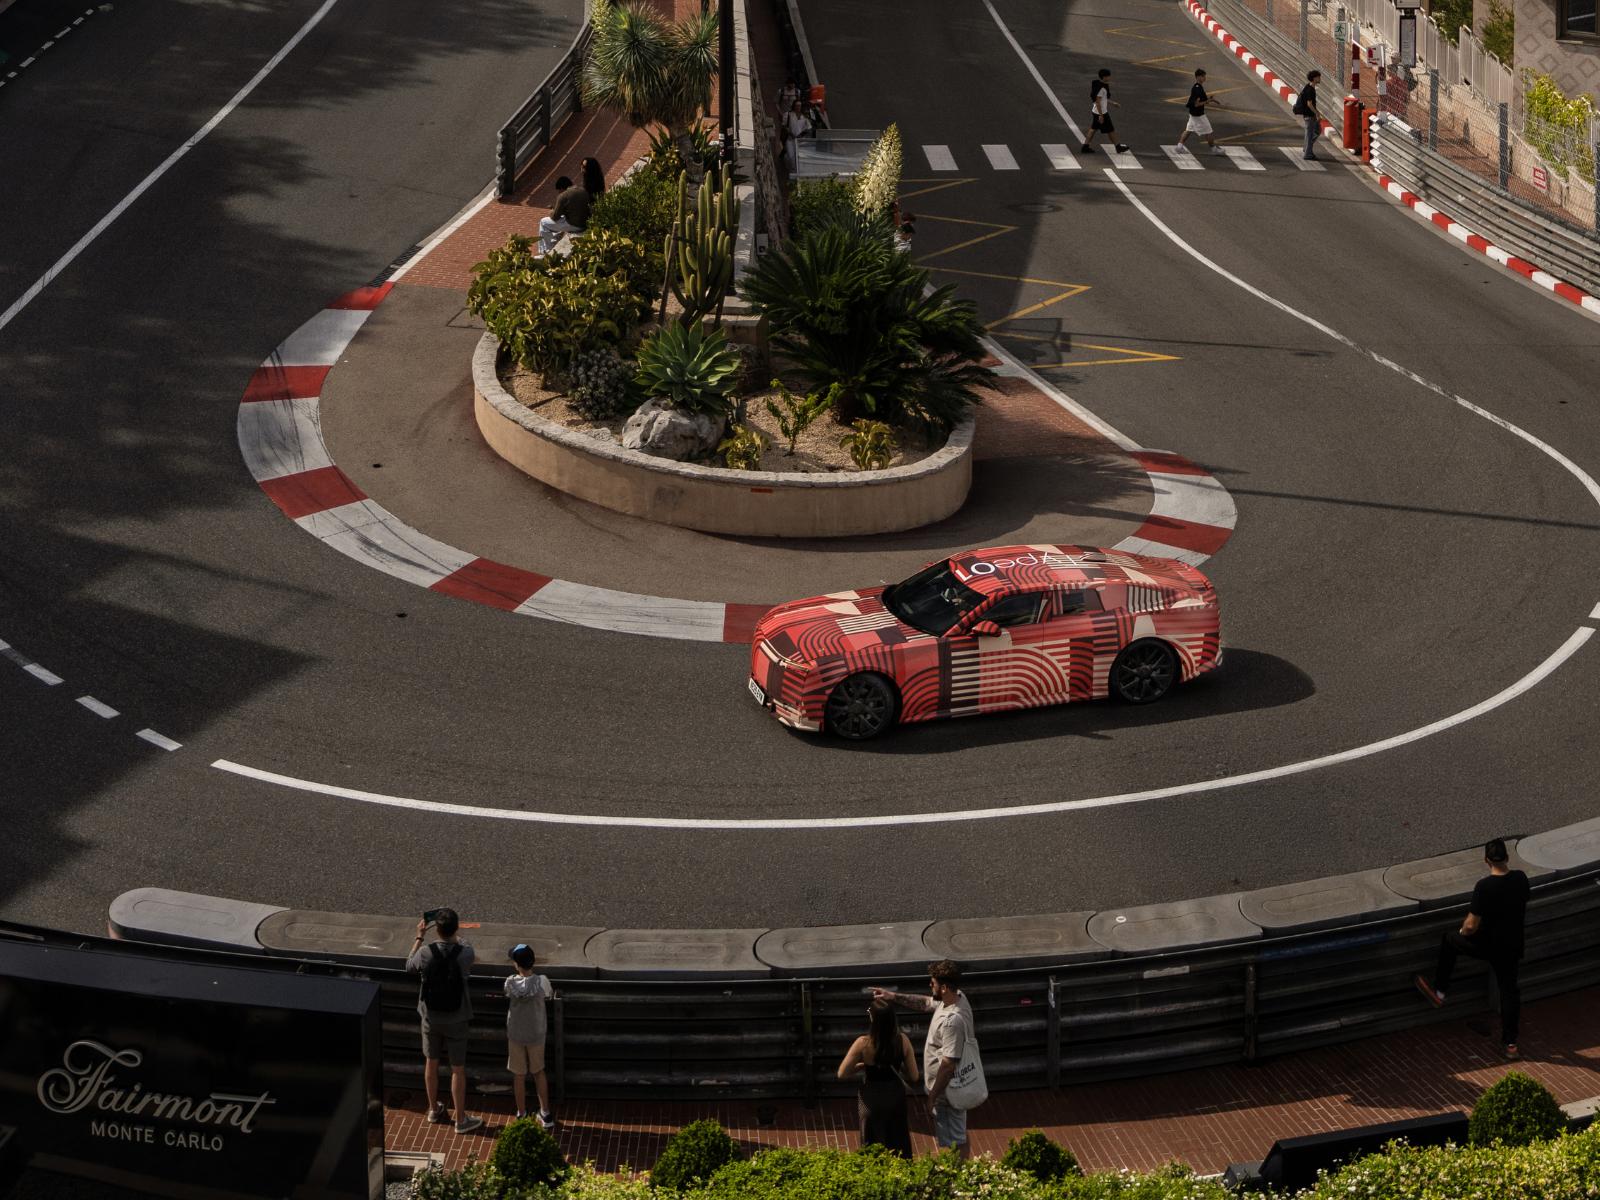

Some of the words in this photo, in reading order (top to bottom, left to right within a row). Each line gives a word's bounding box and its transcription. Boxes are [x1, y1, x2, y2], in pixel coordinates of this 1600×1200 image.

[37, 1040, 277, 1133] Fairmont
[91, 1121, 154, 1143] MONTE
[164, 1131, 223, 1151] CARLO
